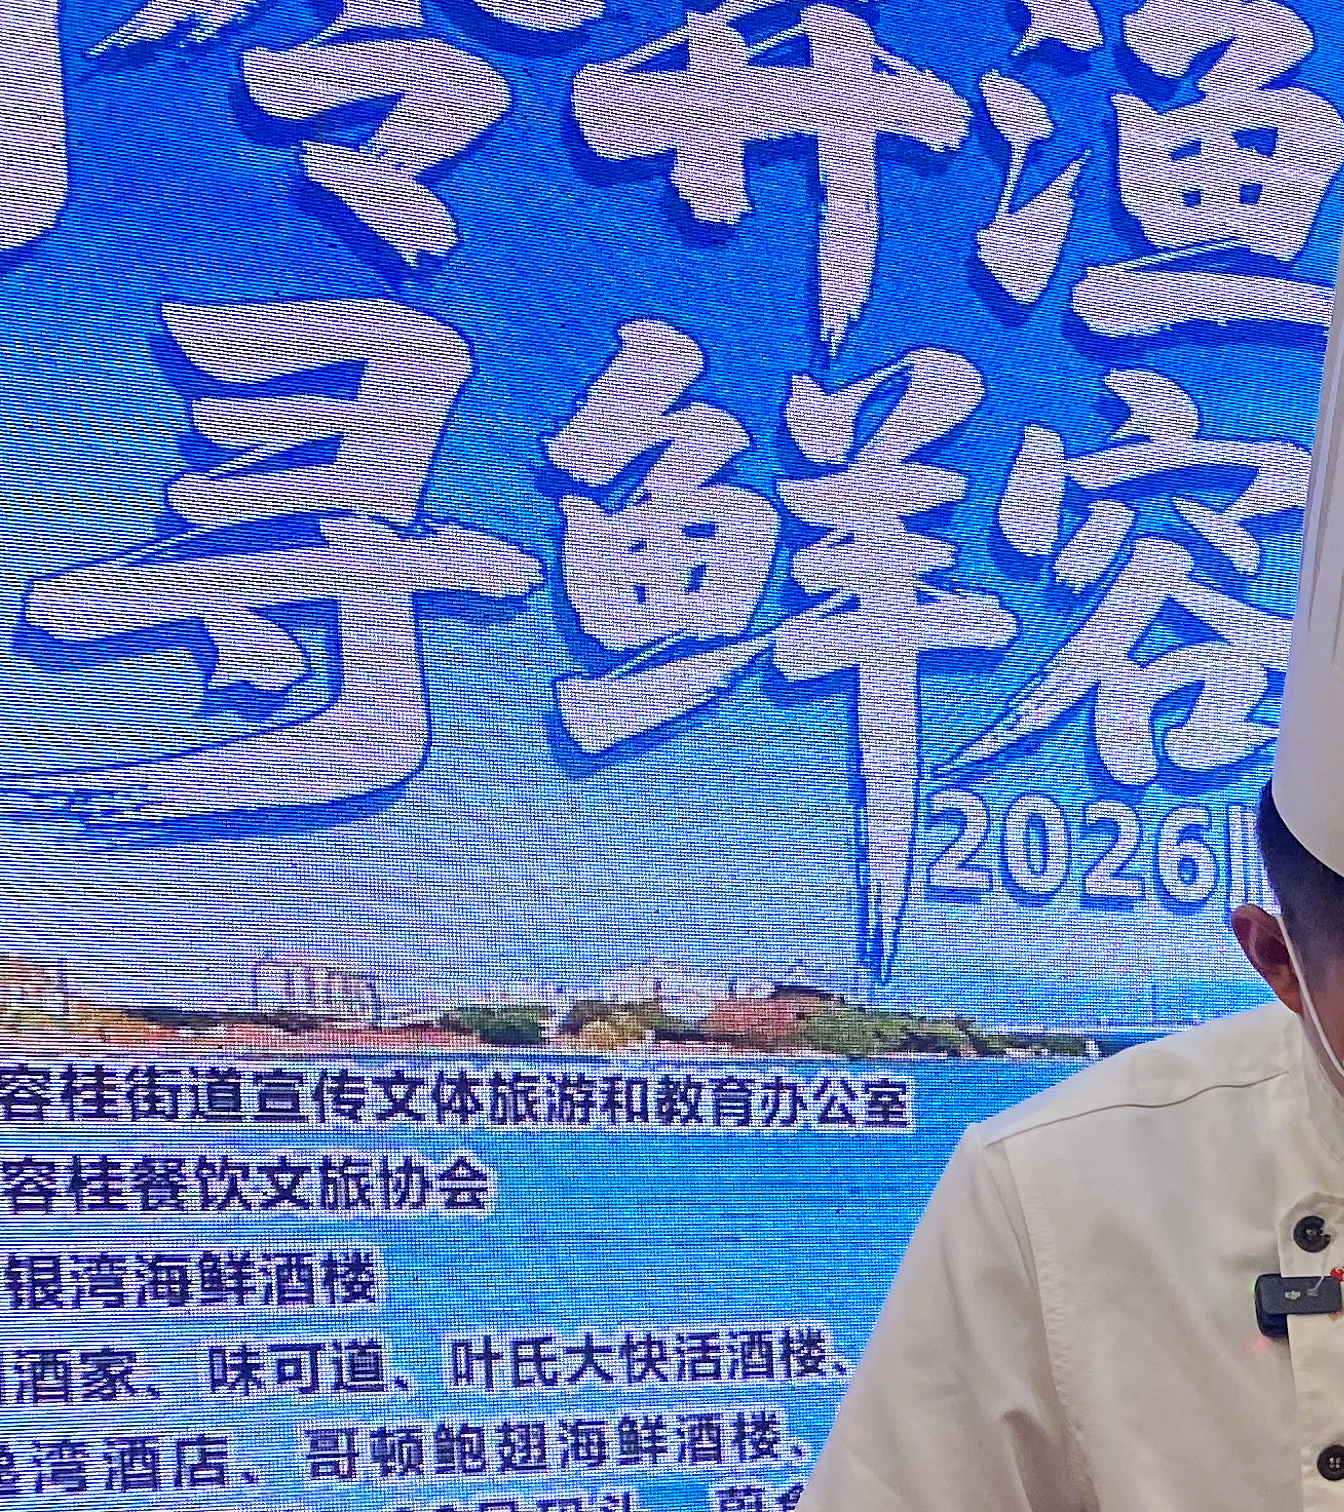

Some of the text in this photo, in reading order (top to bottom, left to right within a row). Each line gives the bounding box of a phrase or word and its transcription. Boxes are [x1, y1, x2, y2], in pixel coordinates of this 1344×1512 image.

[928, 787, 1276, 914] 2026
[0, 1064, 909, 1128] 容桂街道宣传文体旅游和教育办公室
[2, 1155, 488, 1215] 容桂餐饮文旅协会
[6, 1250, 377, 1308] 银湾海鲜酒楼
[0, 1327, 849, 1404] 酒家、味可道、叶氏大快活酒楼、
